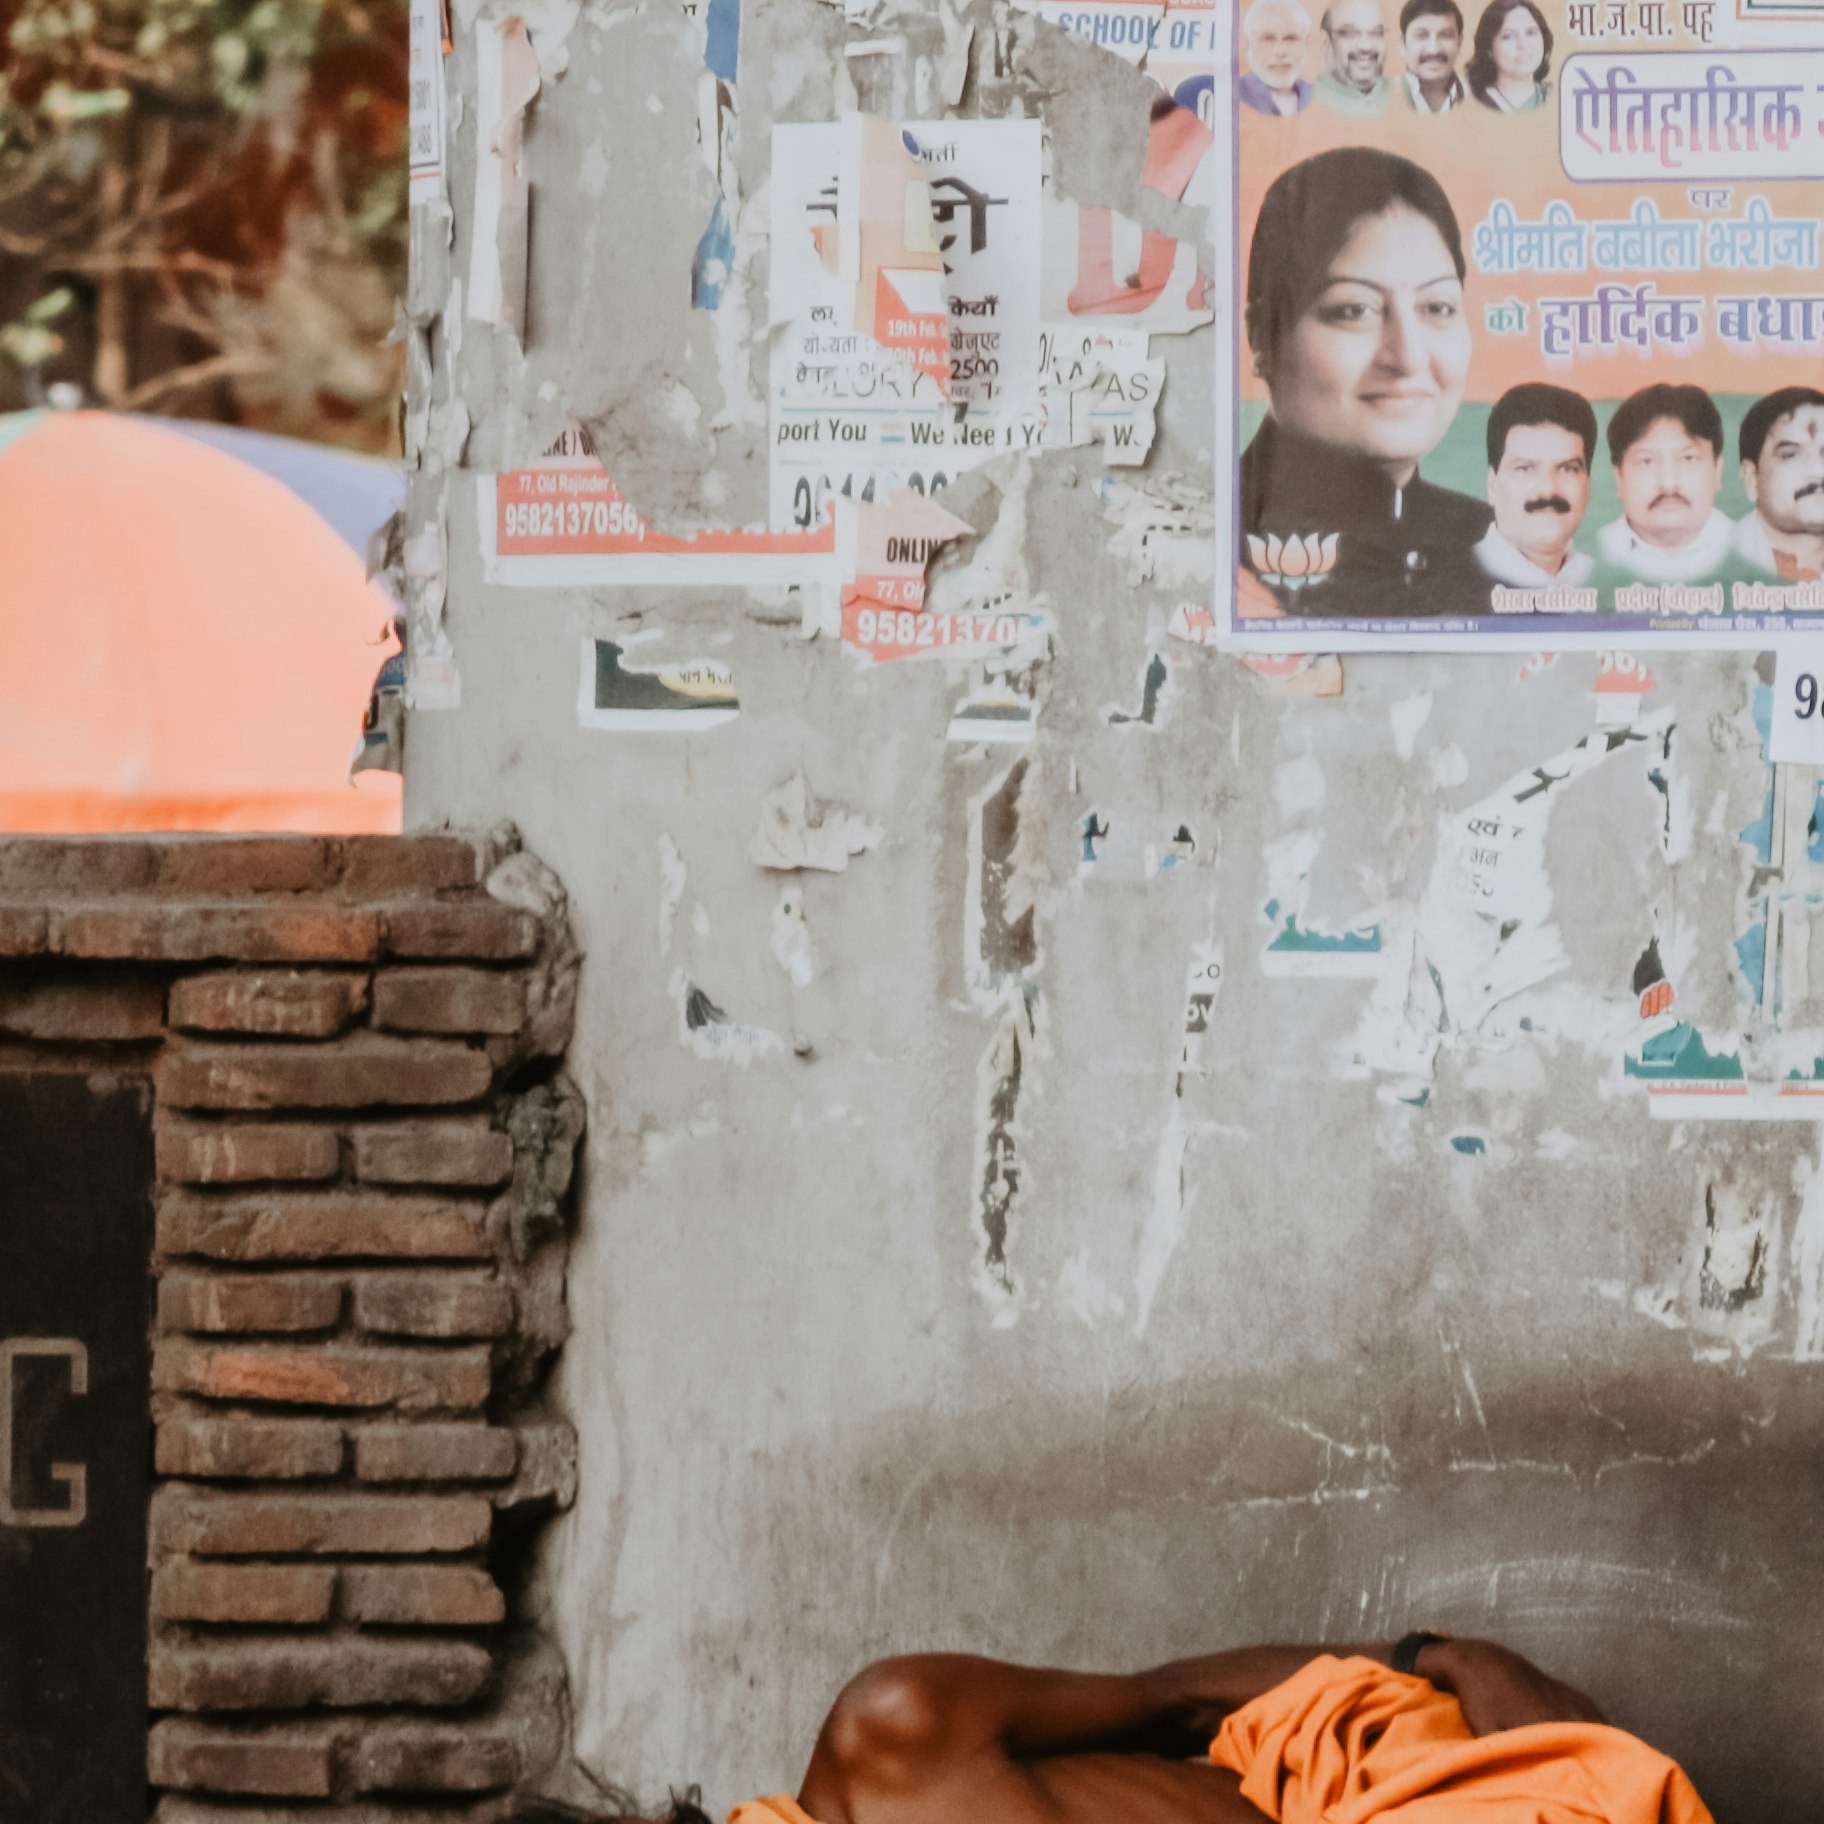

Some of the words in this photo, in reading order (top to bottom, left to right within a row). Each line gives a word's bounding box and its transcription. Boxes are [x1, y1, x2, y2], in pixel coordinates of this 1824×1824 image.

[1572, 64, 1805, 169] ऐतिहासिक
[1690, 187, 1732, 211] पर
[1541, 282, 1704, 356] हार्दिक
[828, 420, 868, 442] You
